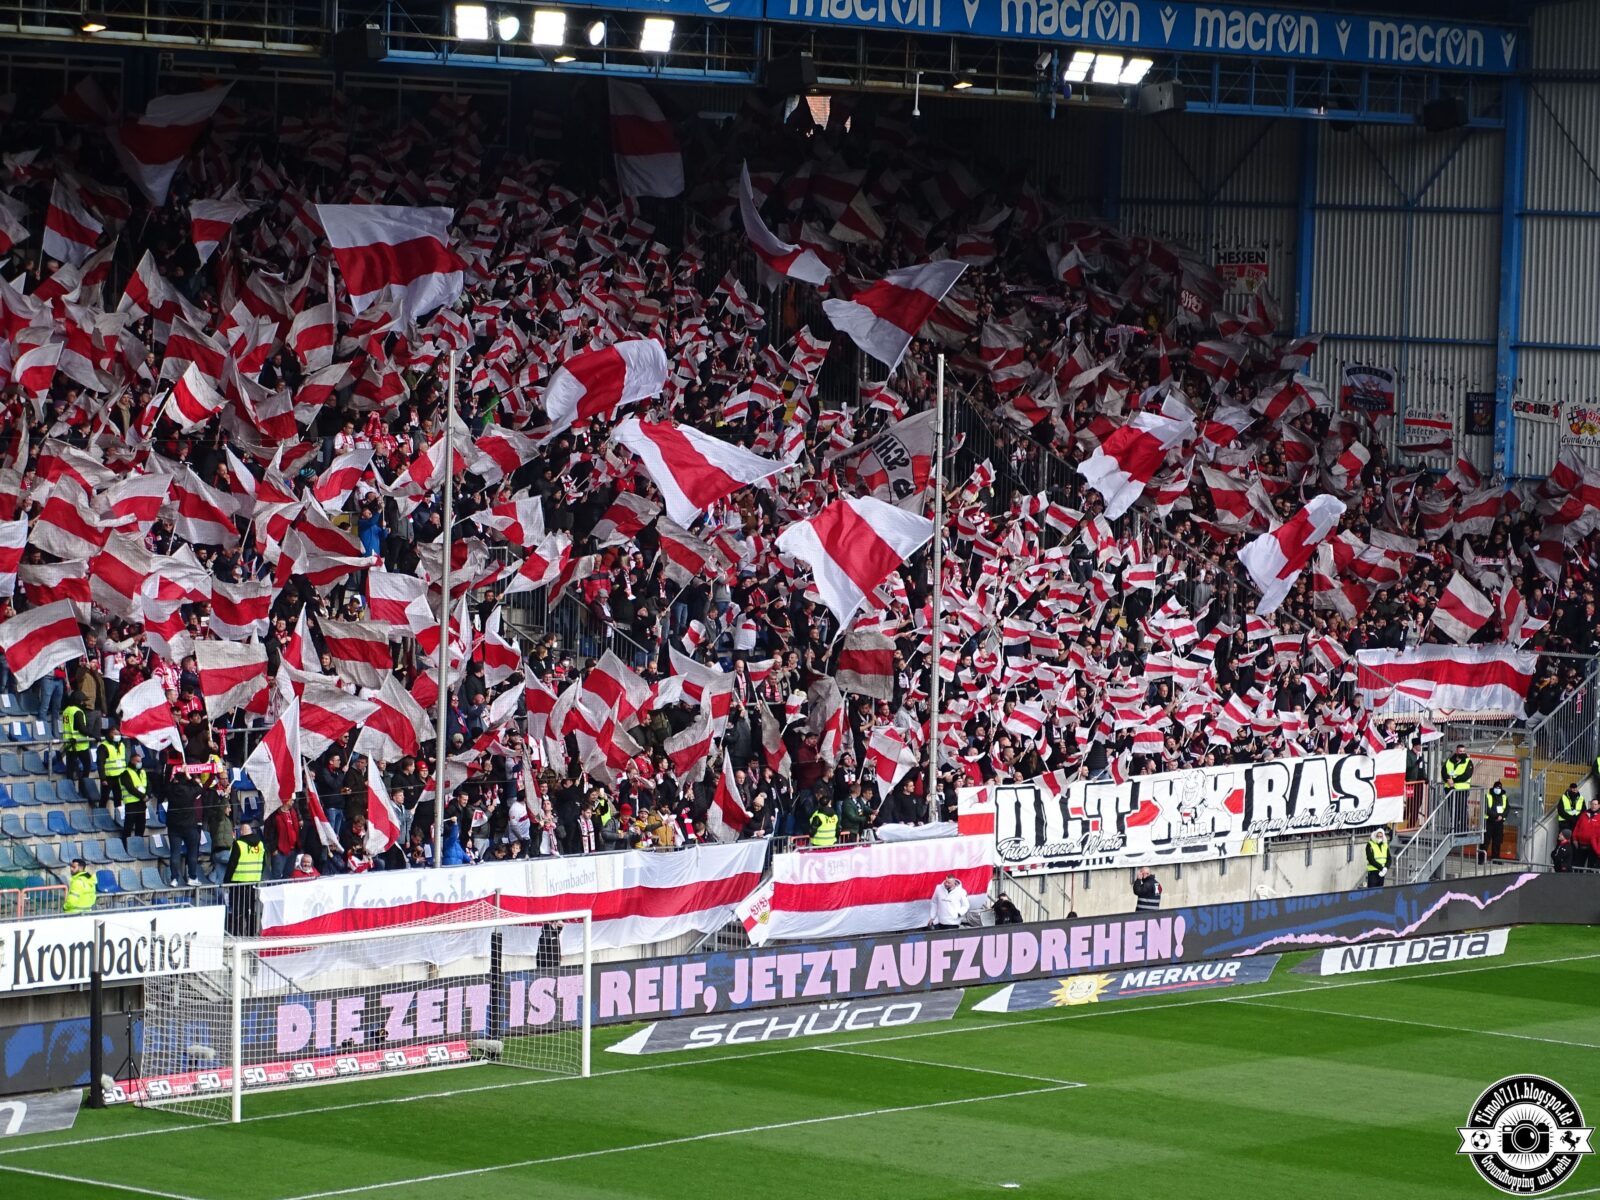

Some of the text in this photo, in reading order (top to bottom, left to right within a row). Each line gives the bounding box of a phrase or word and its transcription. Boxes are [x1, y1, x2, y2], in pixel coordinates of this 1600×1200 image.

[1000, 0, 1140, 42] macron
[1193, 7, 1319, 55] macron
[1368, 20, 1485, 67] macron
[1216, 251, 1266, 264] HESSEN
[13, 917, 198, 985] Krombacher
[1119, 960, 1242, 989] MERKUR
[277, 915, 1186, 1054] DIE ZEIT IST REIF, JETZT AUFZUDREHEN!
[683, 1000, 923, 1050] SCHÜCO
